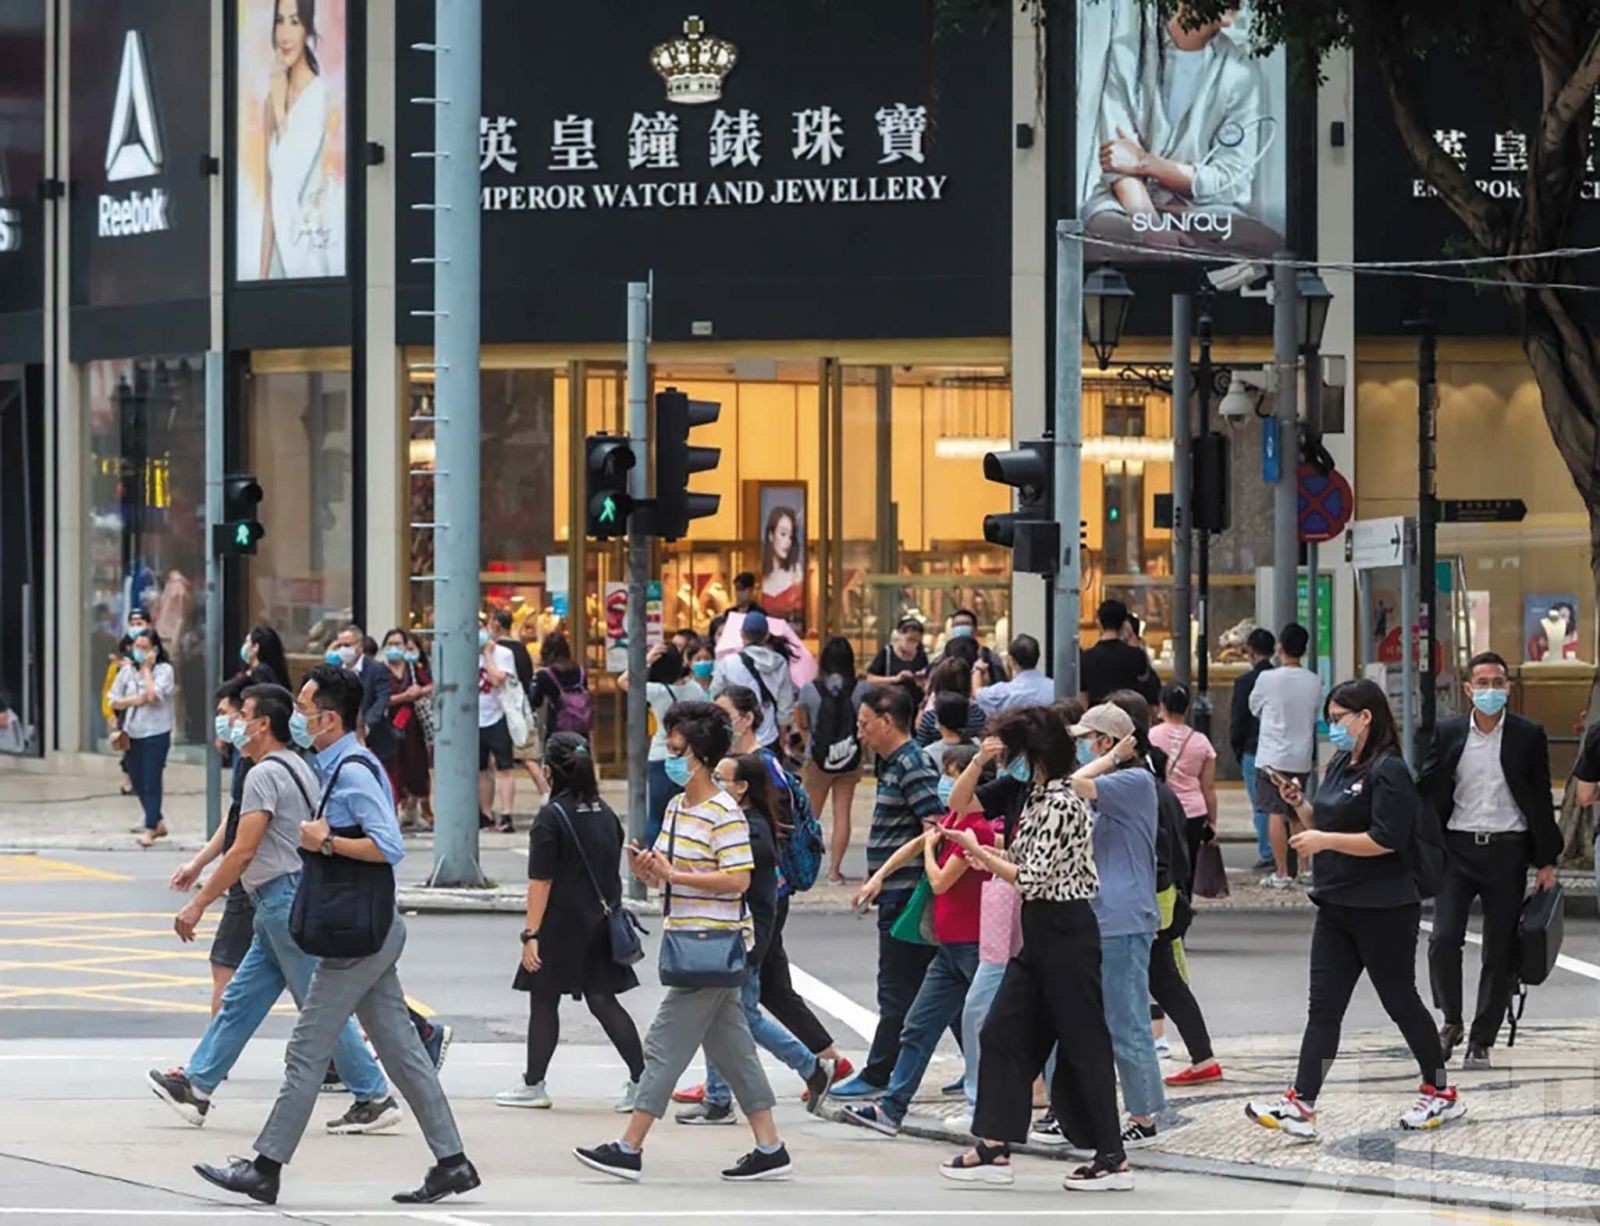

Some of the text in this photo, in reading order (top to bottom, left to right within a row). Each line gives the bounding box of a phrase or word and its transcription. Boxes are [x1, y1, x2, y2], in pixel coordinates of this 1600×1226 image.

[480, 103, 927, 174] 英皇鐘錶珠寶
[98, 188, 169, 237] Reebok
[593, 182, 698, 208] WATCH
[704, 180, 764, 205] AND
[771, 175, 947, 203] JEWELLERY
